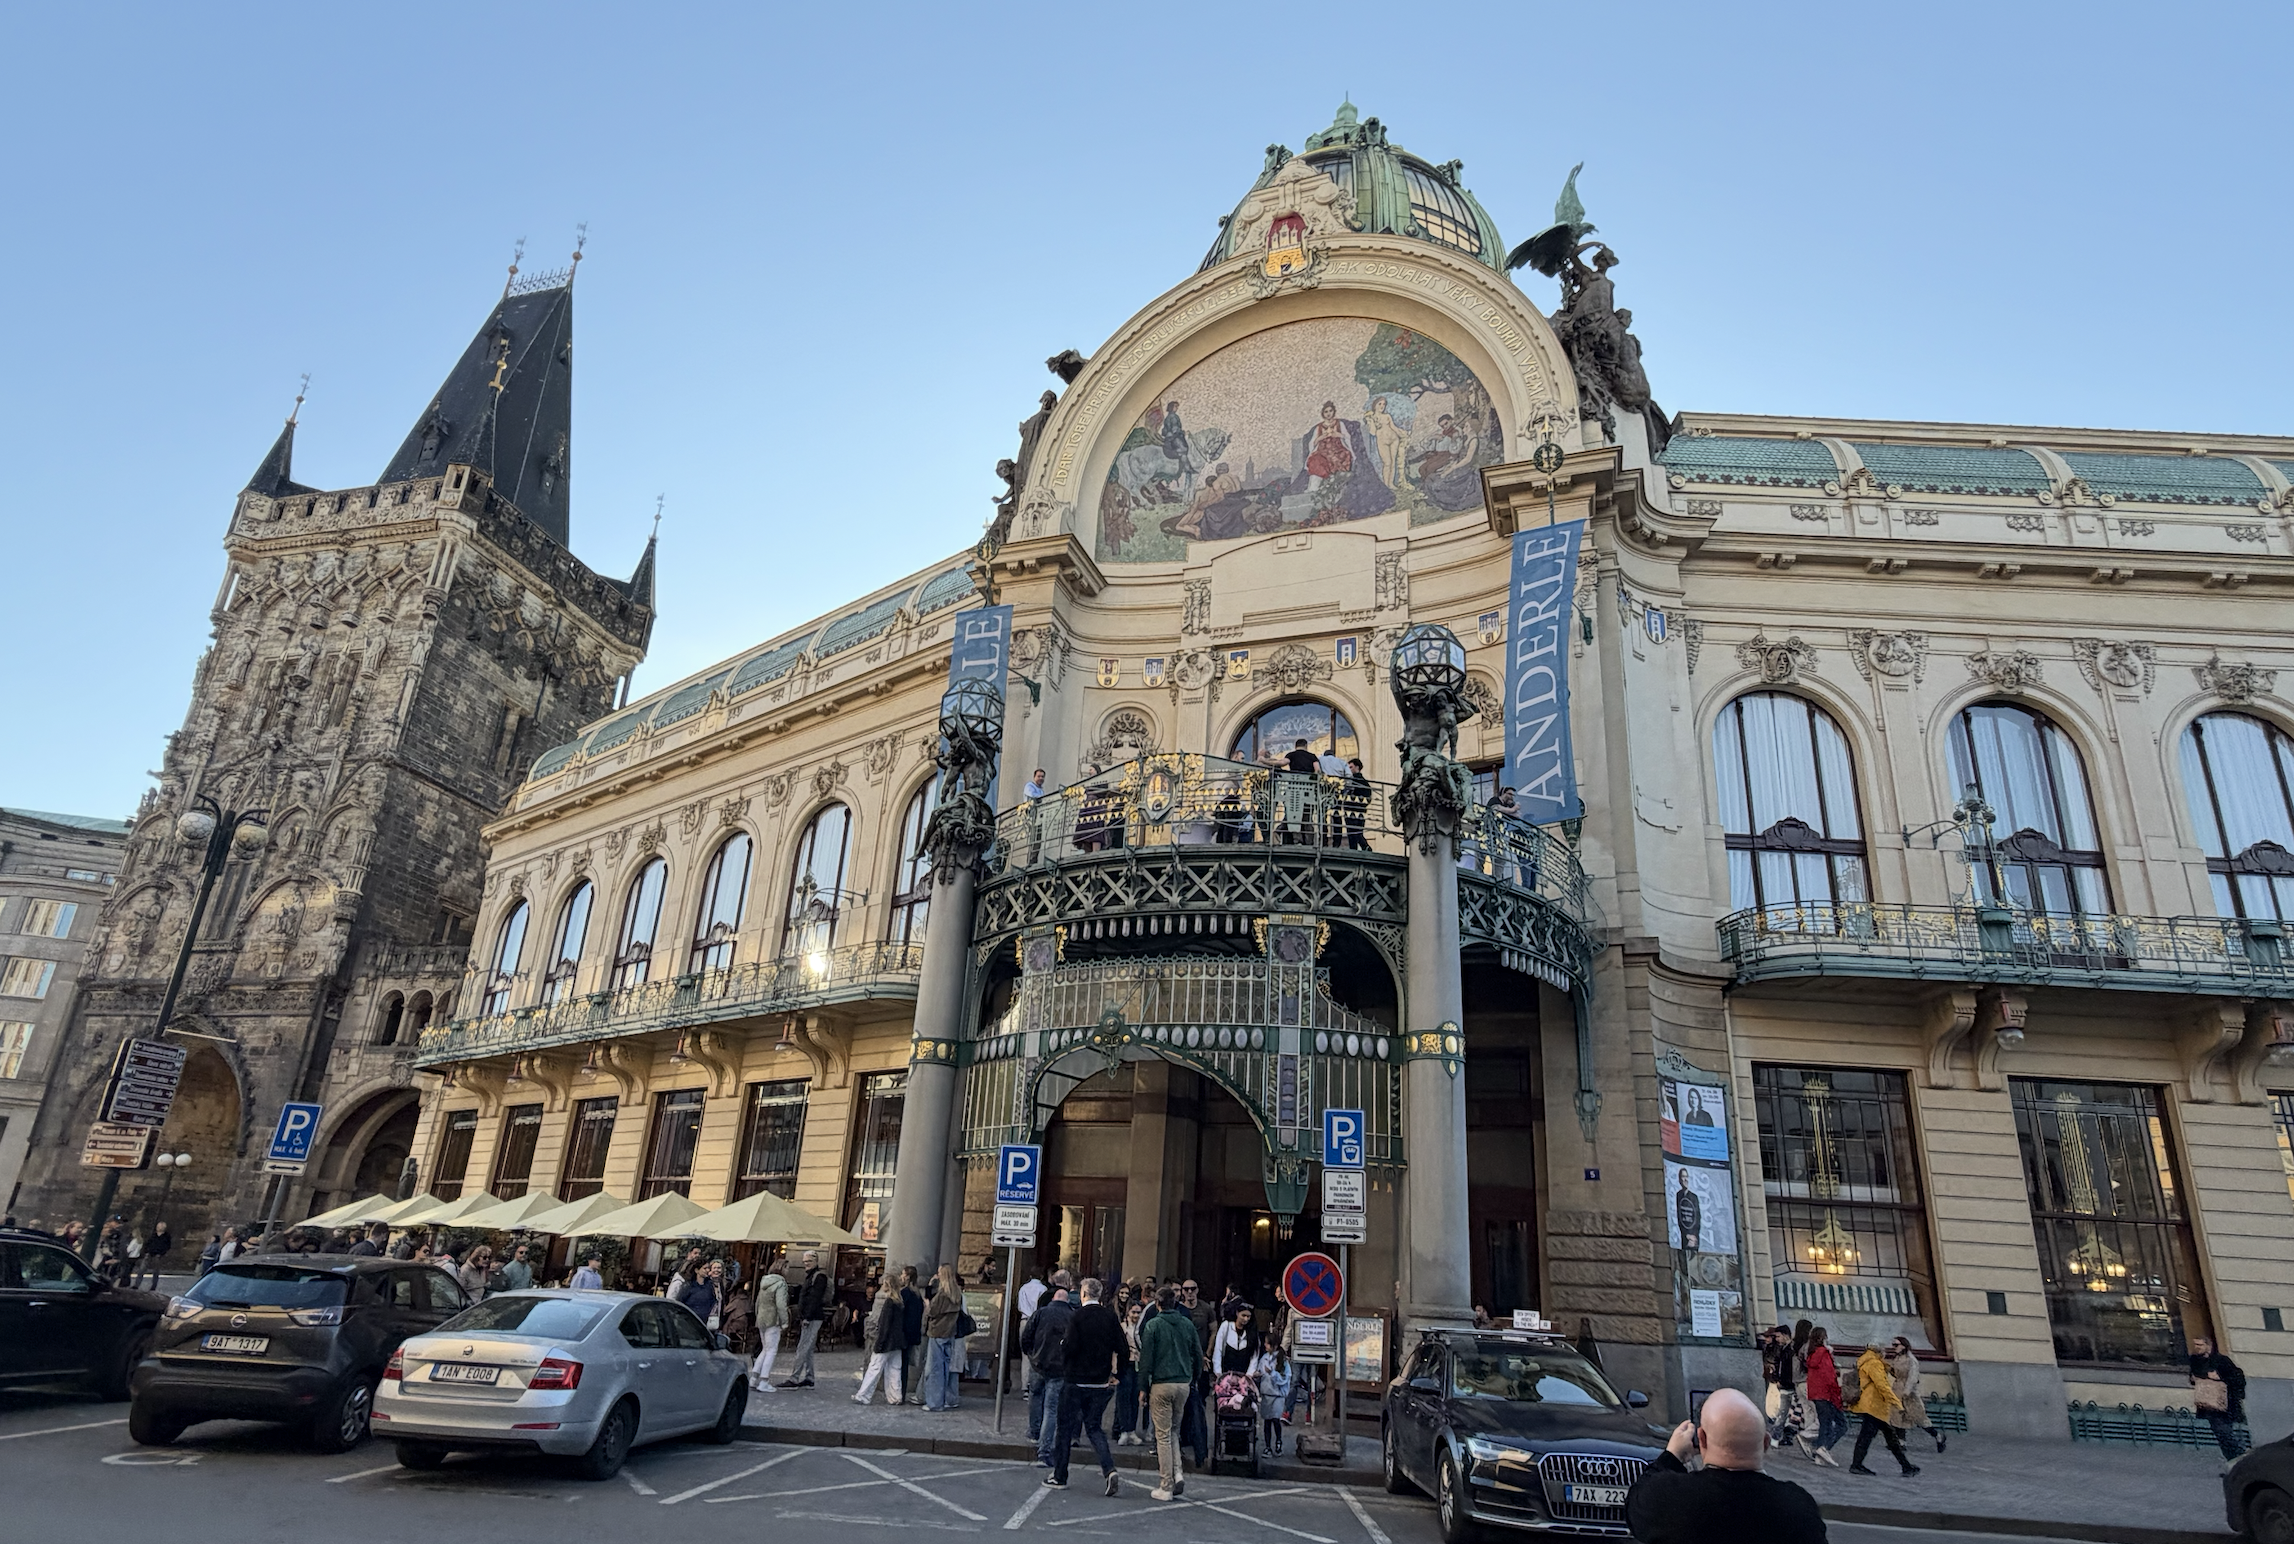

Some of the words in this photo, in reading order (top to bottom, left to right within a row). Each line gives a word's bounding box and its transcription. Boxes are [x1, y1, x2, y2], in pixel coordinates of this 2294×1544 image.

[1515, 530, 1571, 808] ANDERLE
[281, 1109, 311, 1142] P
[1332, 1115, 1356, 1150] P
[1006, 1151, 1031, 1186] P
[1346, 1319, 1381, 1331] NDERLE
[210, 1336, 231, 1348] 9AT
[238, 1338, 264, 1350] 1317
[441, 1366, 461, 1379] 1AN
[1575, 1488, 1597, 1502] 7AX
